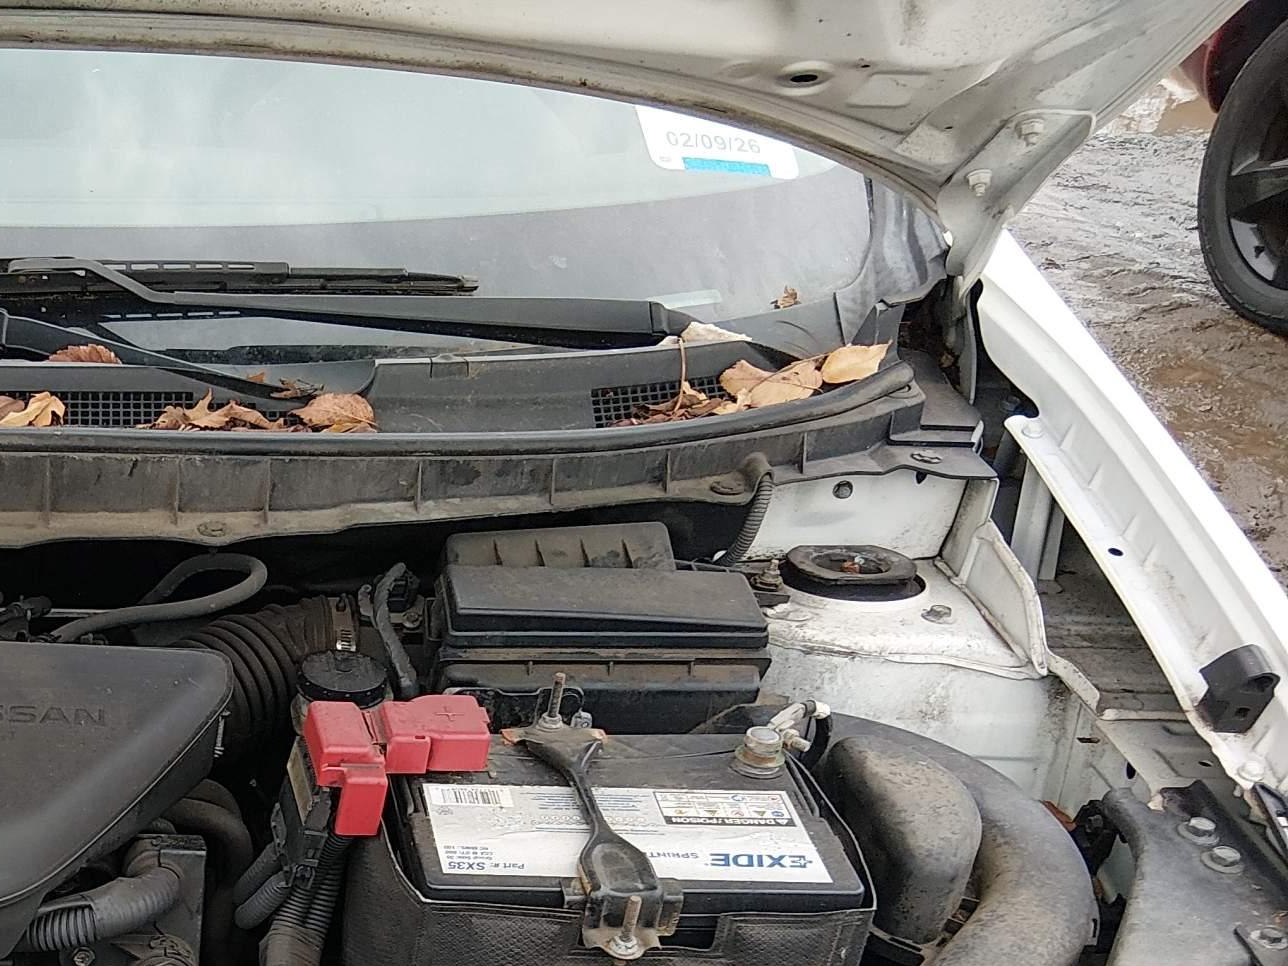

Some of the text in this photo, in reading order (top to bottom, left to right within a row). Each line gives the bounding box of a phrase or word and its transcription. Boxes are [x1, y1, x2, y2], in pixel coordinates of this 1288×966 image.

[665, 130, 761, 154] 02/09/26
[724, 818, 773, 826] DANGER
[710, 852, 812, 869] EXIDE
[447, 861, 487, 871] SX35
[504, 862, 525, 870] Part
